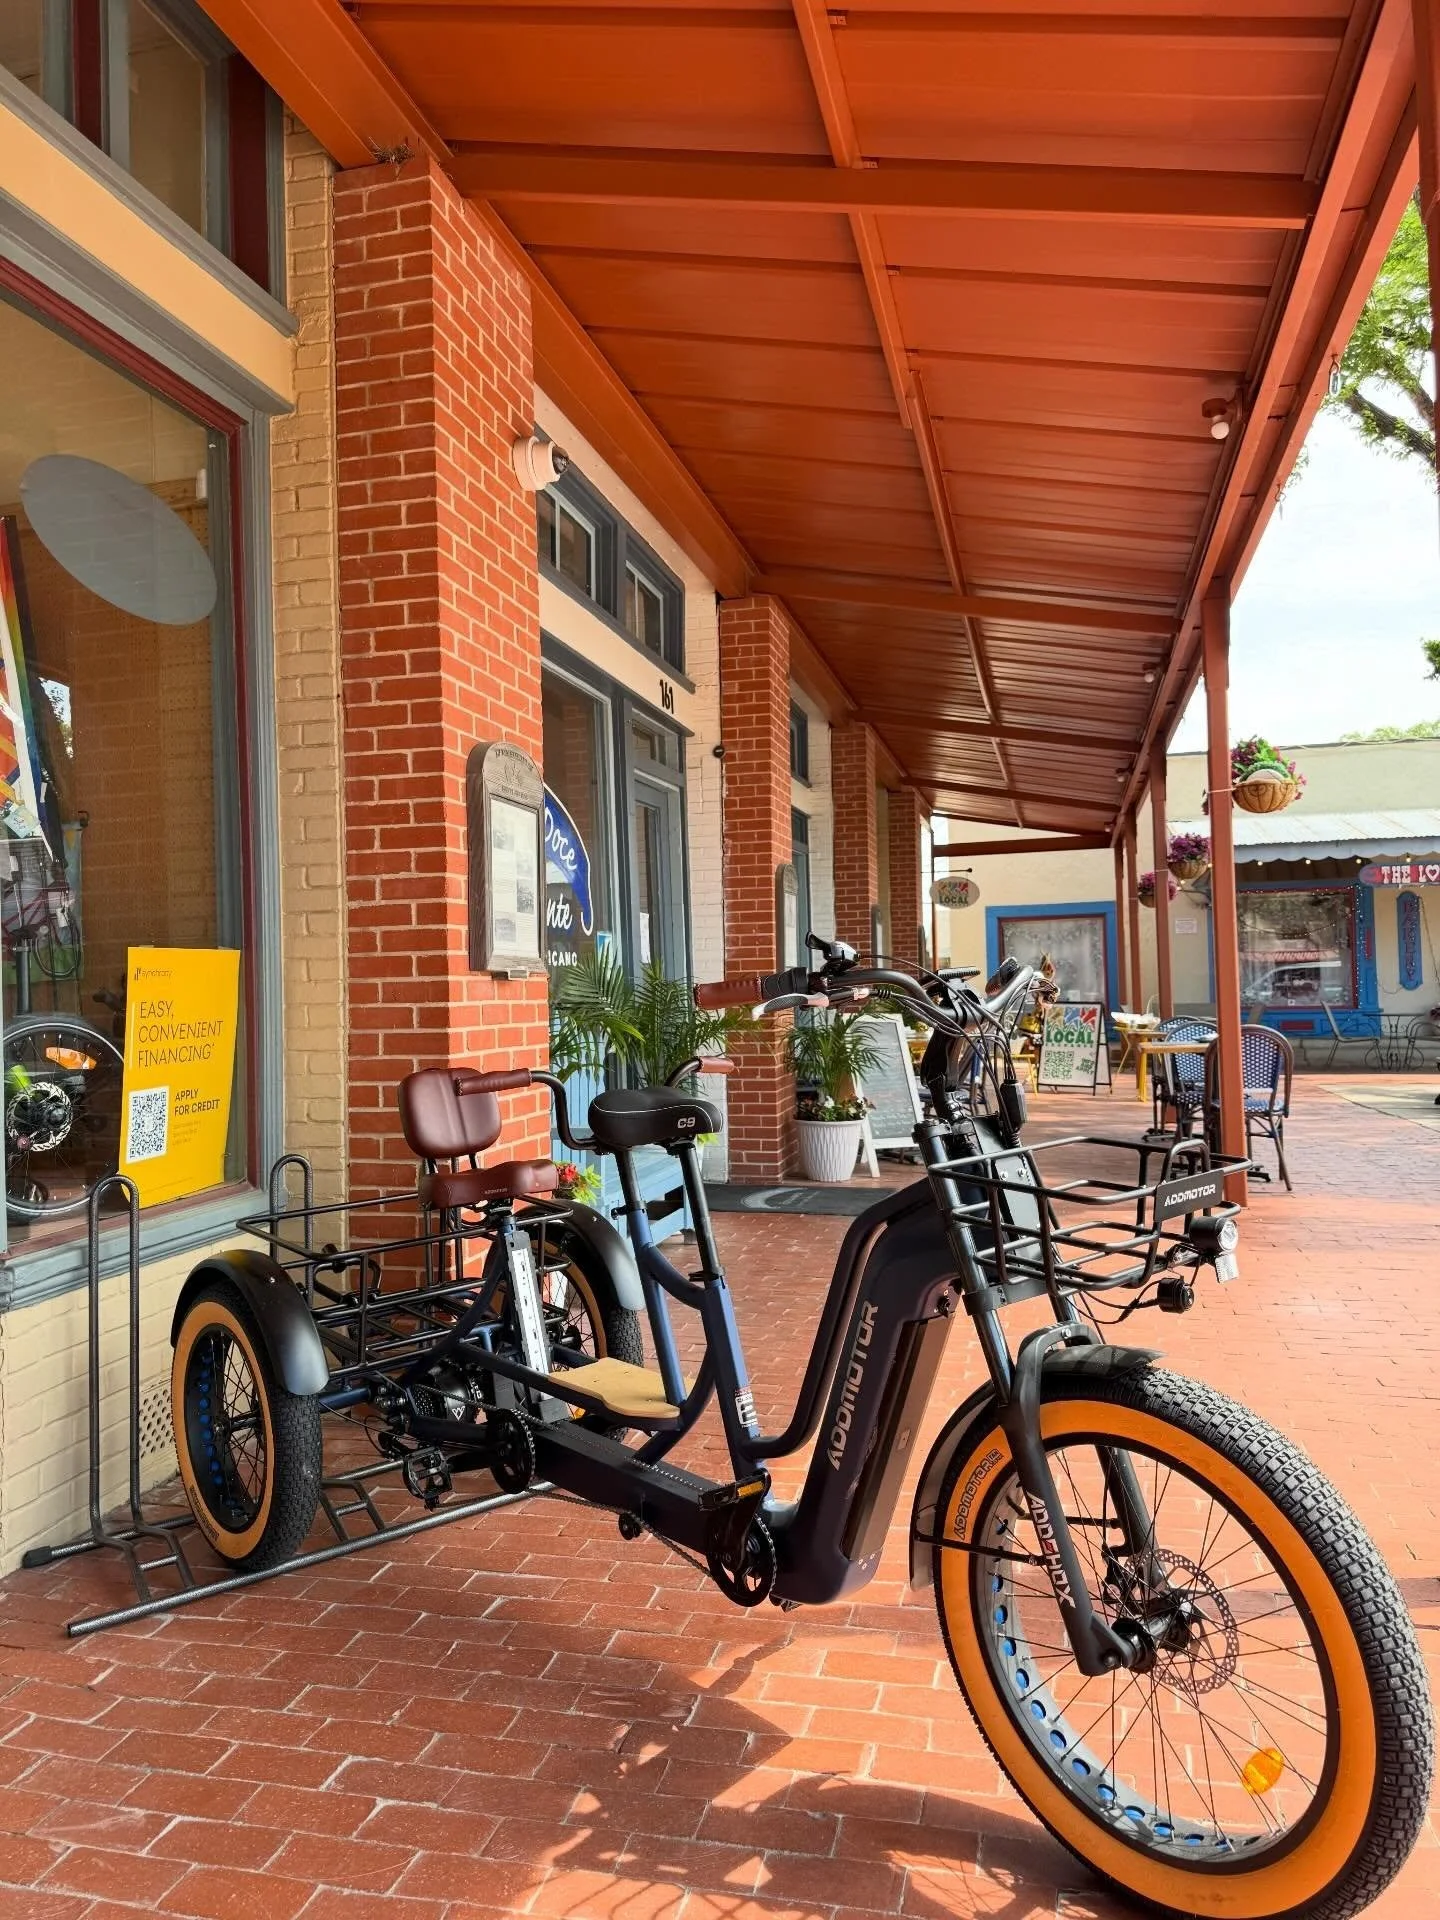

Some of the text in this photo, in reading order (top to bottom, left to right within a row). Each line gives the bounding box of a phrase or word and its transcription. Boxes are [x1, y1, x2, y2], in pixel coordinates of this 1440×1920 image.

[660, 679, 674, 714] 161
[1381, 865, 1411, 884] THE
[938, 895, 969, 904] LOCAL
[139, 1000, 174, 1020] EASY,
[138, 1020, 223, 1043] CONVENIENT
[1045, 1028, 1094, 1044] LOCAL
[174, 1089, 199, 1102] APPLY
[174, 1099, 220, 1116] FOR CREDIT
[1164, 1184, 1216, 1206] ADDMOTOR
[827, 1301, 878, 1471] ADDMOTOR
[953, 1456, 994, 1541] ADDMOTOR
